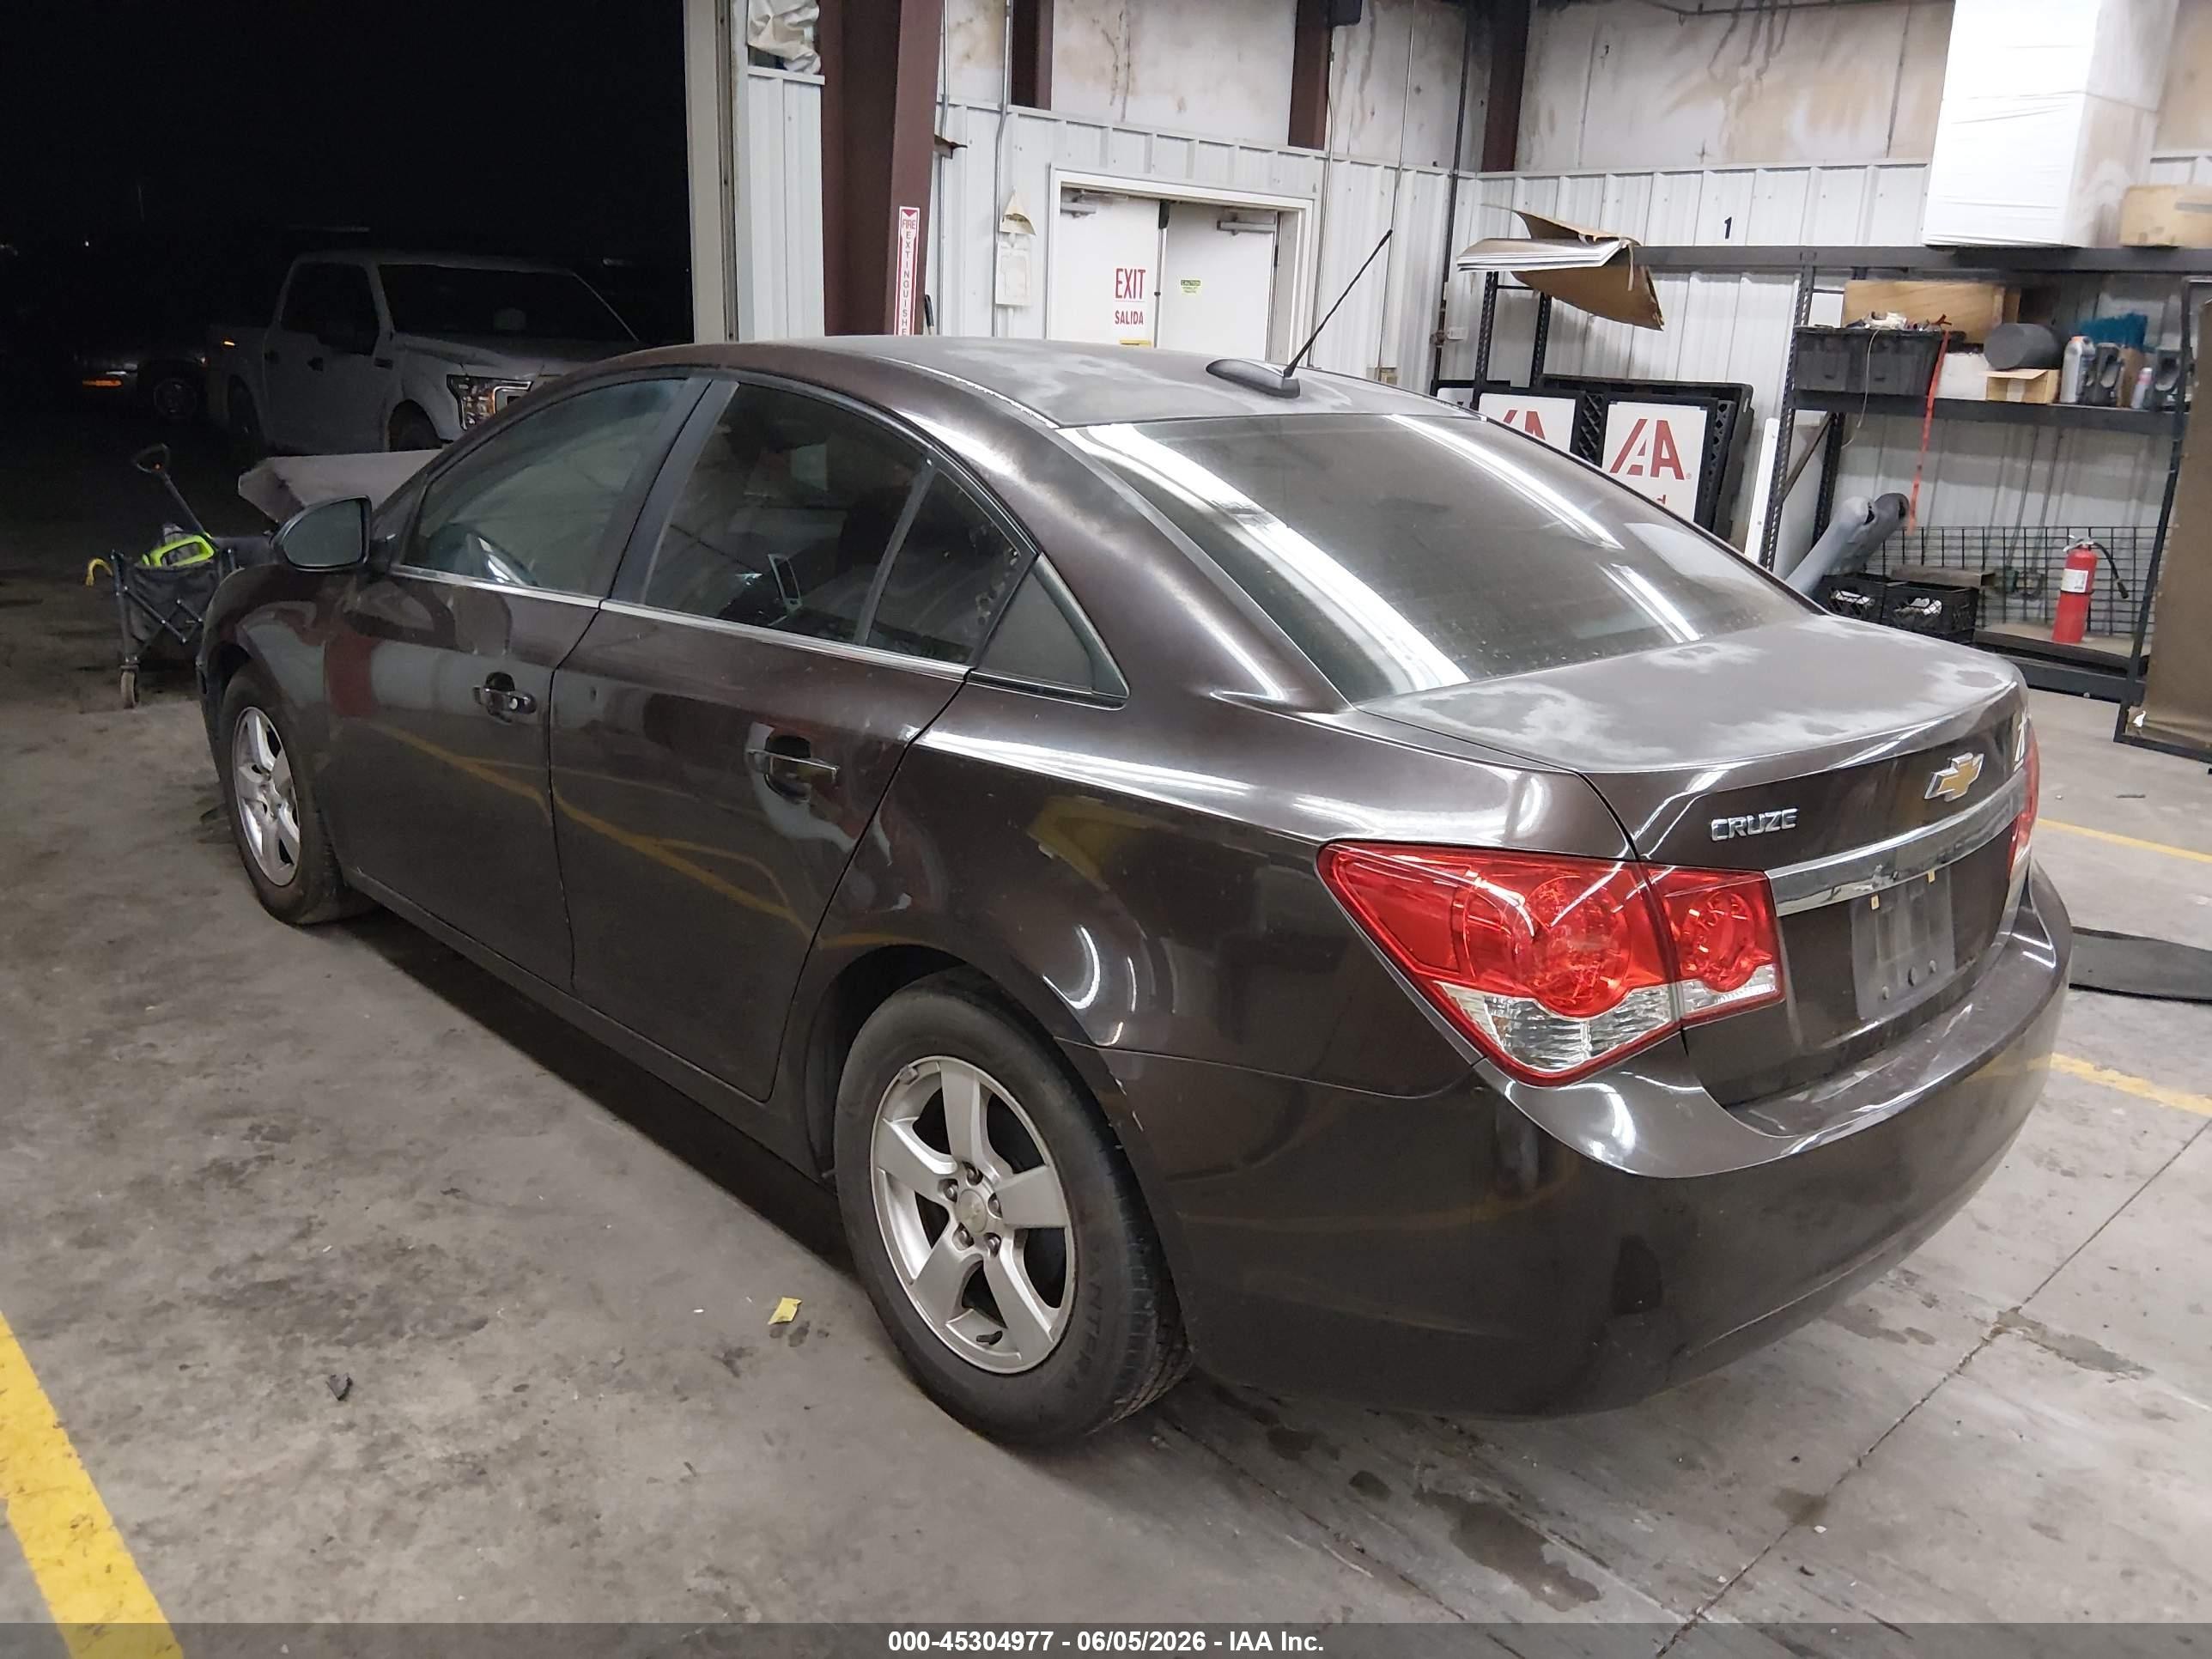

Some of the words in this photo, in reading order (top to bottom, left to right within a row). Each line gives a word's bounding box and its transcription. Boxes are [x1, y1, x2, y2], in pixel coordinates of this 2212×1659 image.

[902, 218, 916, 230] FIRE
[1724, 216, 1733, 240] 1
[901, 231, 912, 335] EXTINGUISHE
[1115, 268, 1146, 300] EXIT
[1115, 310, 1144, 325] SALIDA
[1711, 808, 1798, 842] CRUZE
